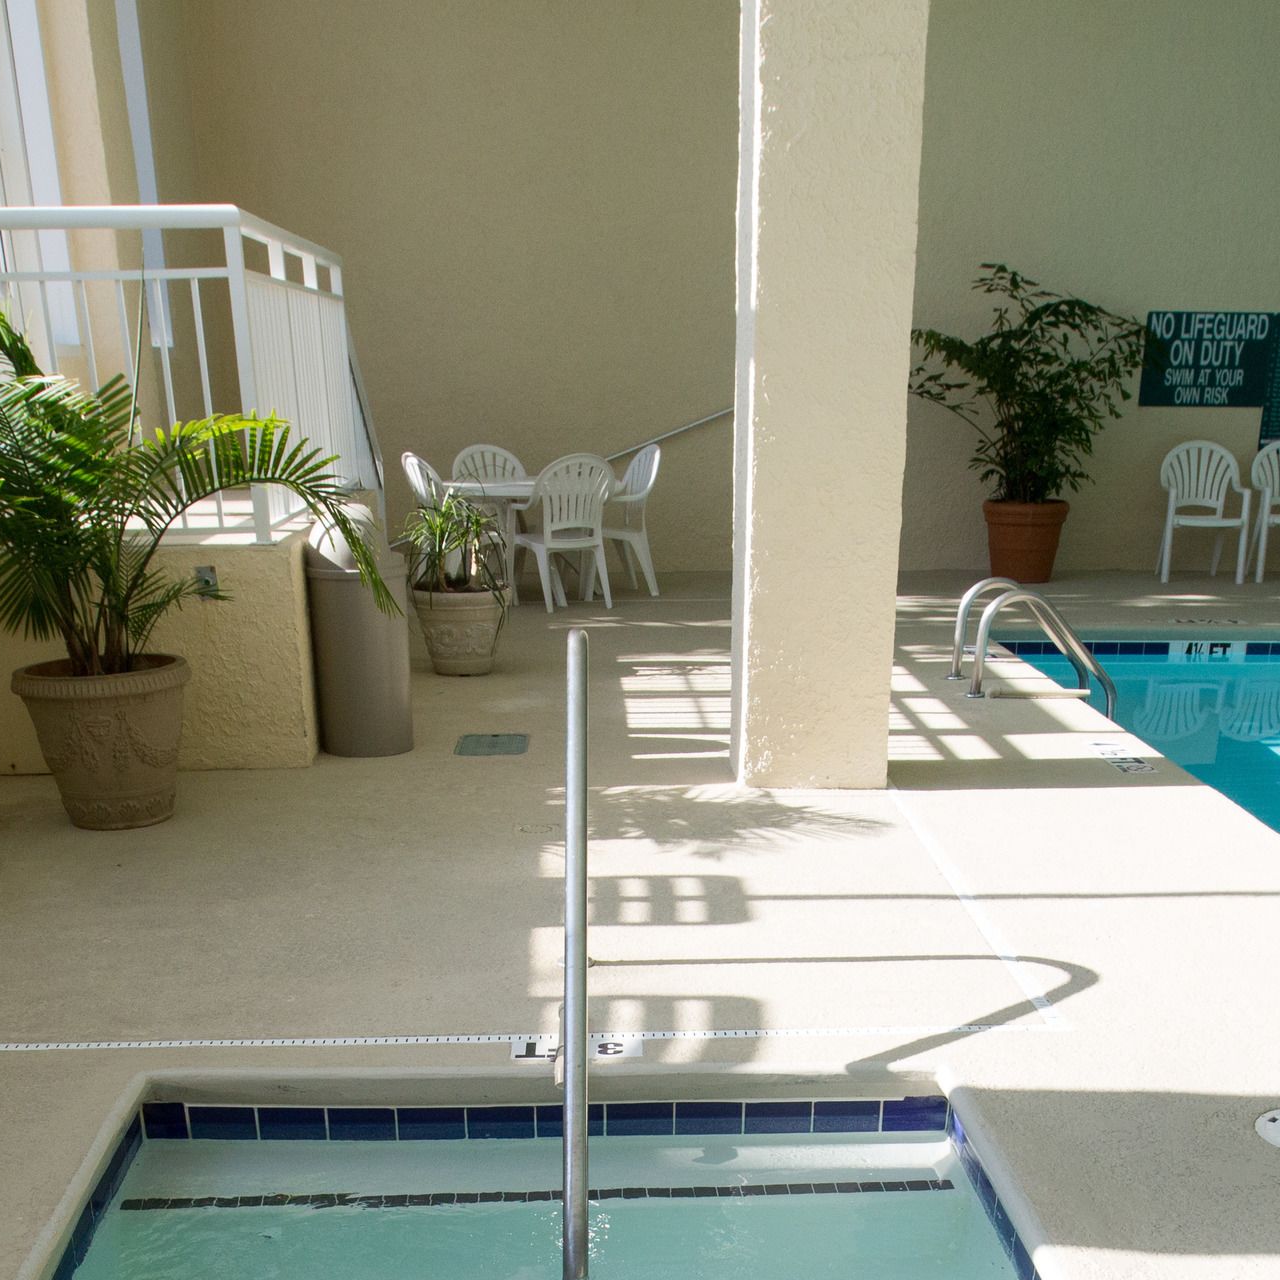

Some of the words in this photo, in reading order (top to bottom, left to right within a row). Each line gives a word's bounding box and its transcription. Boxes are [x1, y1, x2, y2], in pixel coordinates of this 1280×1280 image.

[1151, 313, 1175, 339] NO
[1180, 313, 1269, 340] LIFEGUARD
[1170, 340, 1195, 366] ON
[1200, 341, 1245, 367] DUTY
[1164, 368, 1195, 386] SWIM
[1197, 369, 1211, 386] AT
[1215, 369, 1244, 386] YOUR
[1174, 386, 1200, 404] OWN
[1203, 387, 1229, 405] RISK
